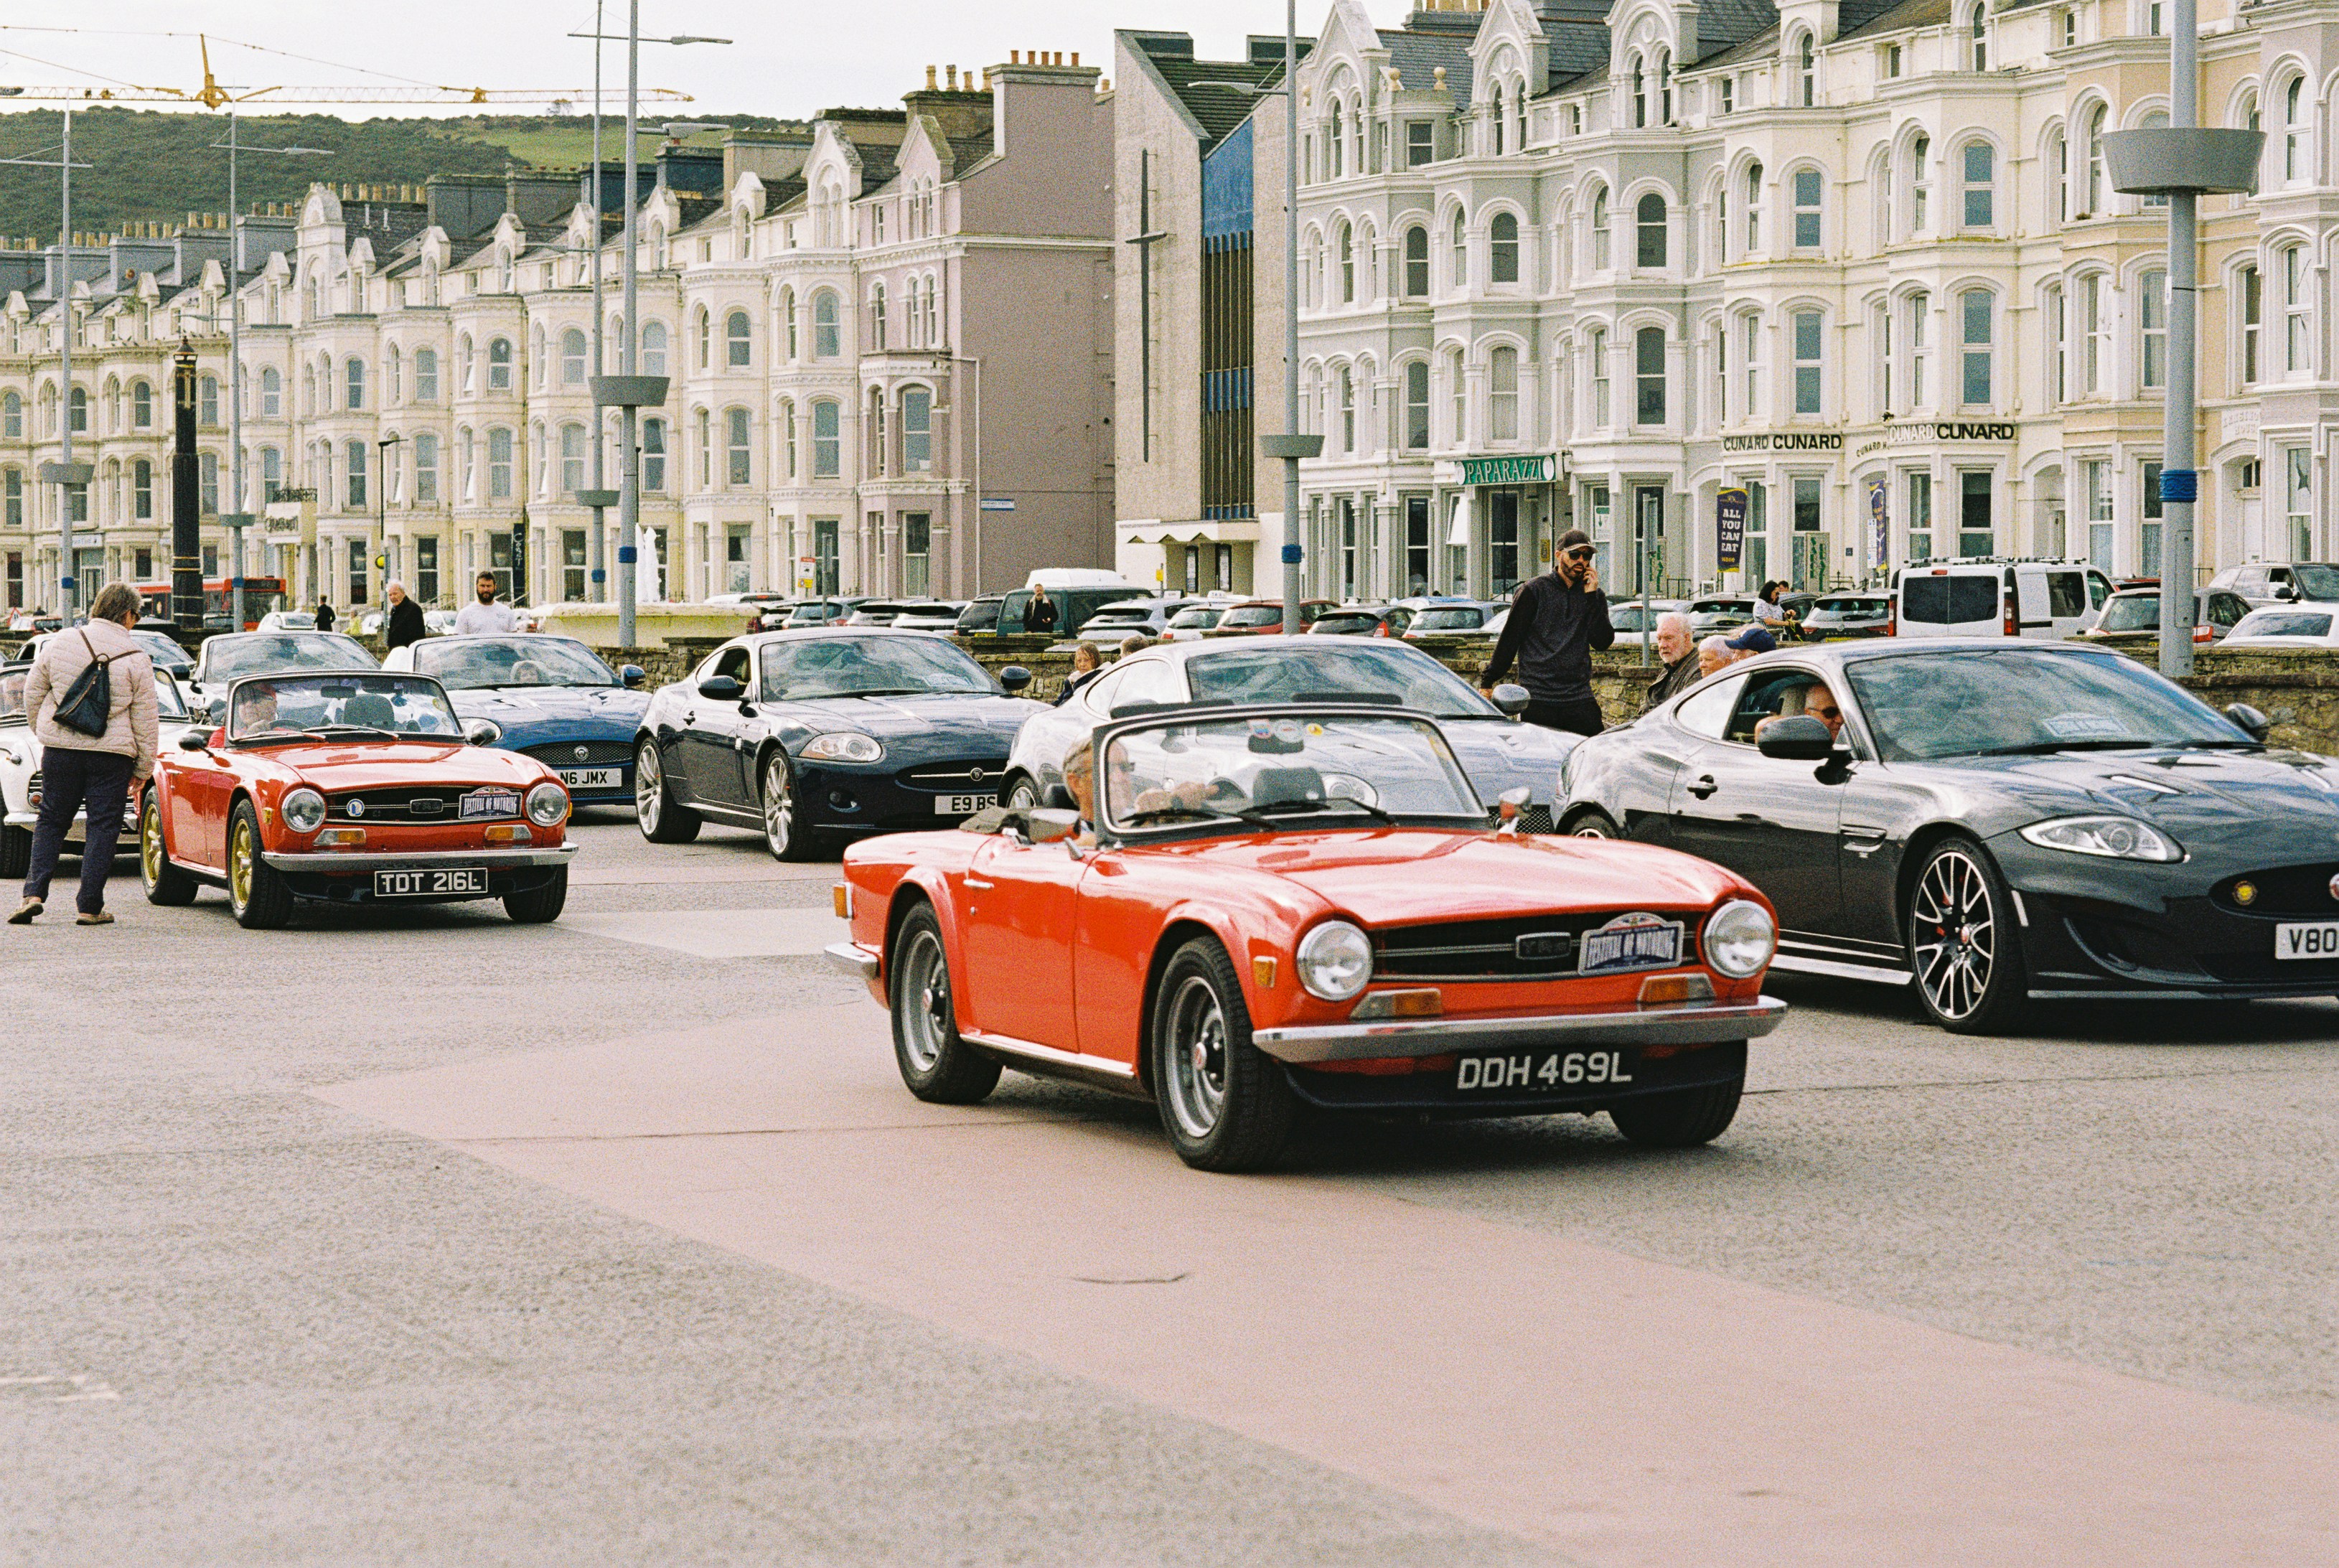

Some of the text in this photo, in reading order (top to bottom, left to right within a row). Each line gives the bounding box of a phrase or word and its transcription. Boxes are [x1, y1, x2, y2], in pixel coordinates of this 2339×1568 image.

[1890, 424, 1934, 441] CUNARD
[1936, 423, 2015, 440] CUNARD
[1723, 436, 1768, 451] CUNARD
[1773, 434, 1842, 449] CUNARD
[1856, 441, 1881, 457] CUNARD
[1466, 459, 1542, 484] PAPARAZZI
[1722, 509, 1740, 518] ALL
[1722, 520, 1740, 530] YOU
[1721, 532, 1740, 541] CAN
[1721, 543, 1738, 552] EAT
[560, 771, 607, 785] N6 JMX
[464, 797, 484, 815] FESTIVAL
[486, 797, 492, 809] OF
[952, 797, 972, 812] E9
[380, 871, 482, 893] TDT 216L
[2289, 928, 2337, 953] V80
[1457, 1051, 1633, 1089] DDH 469L
